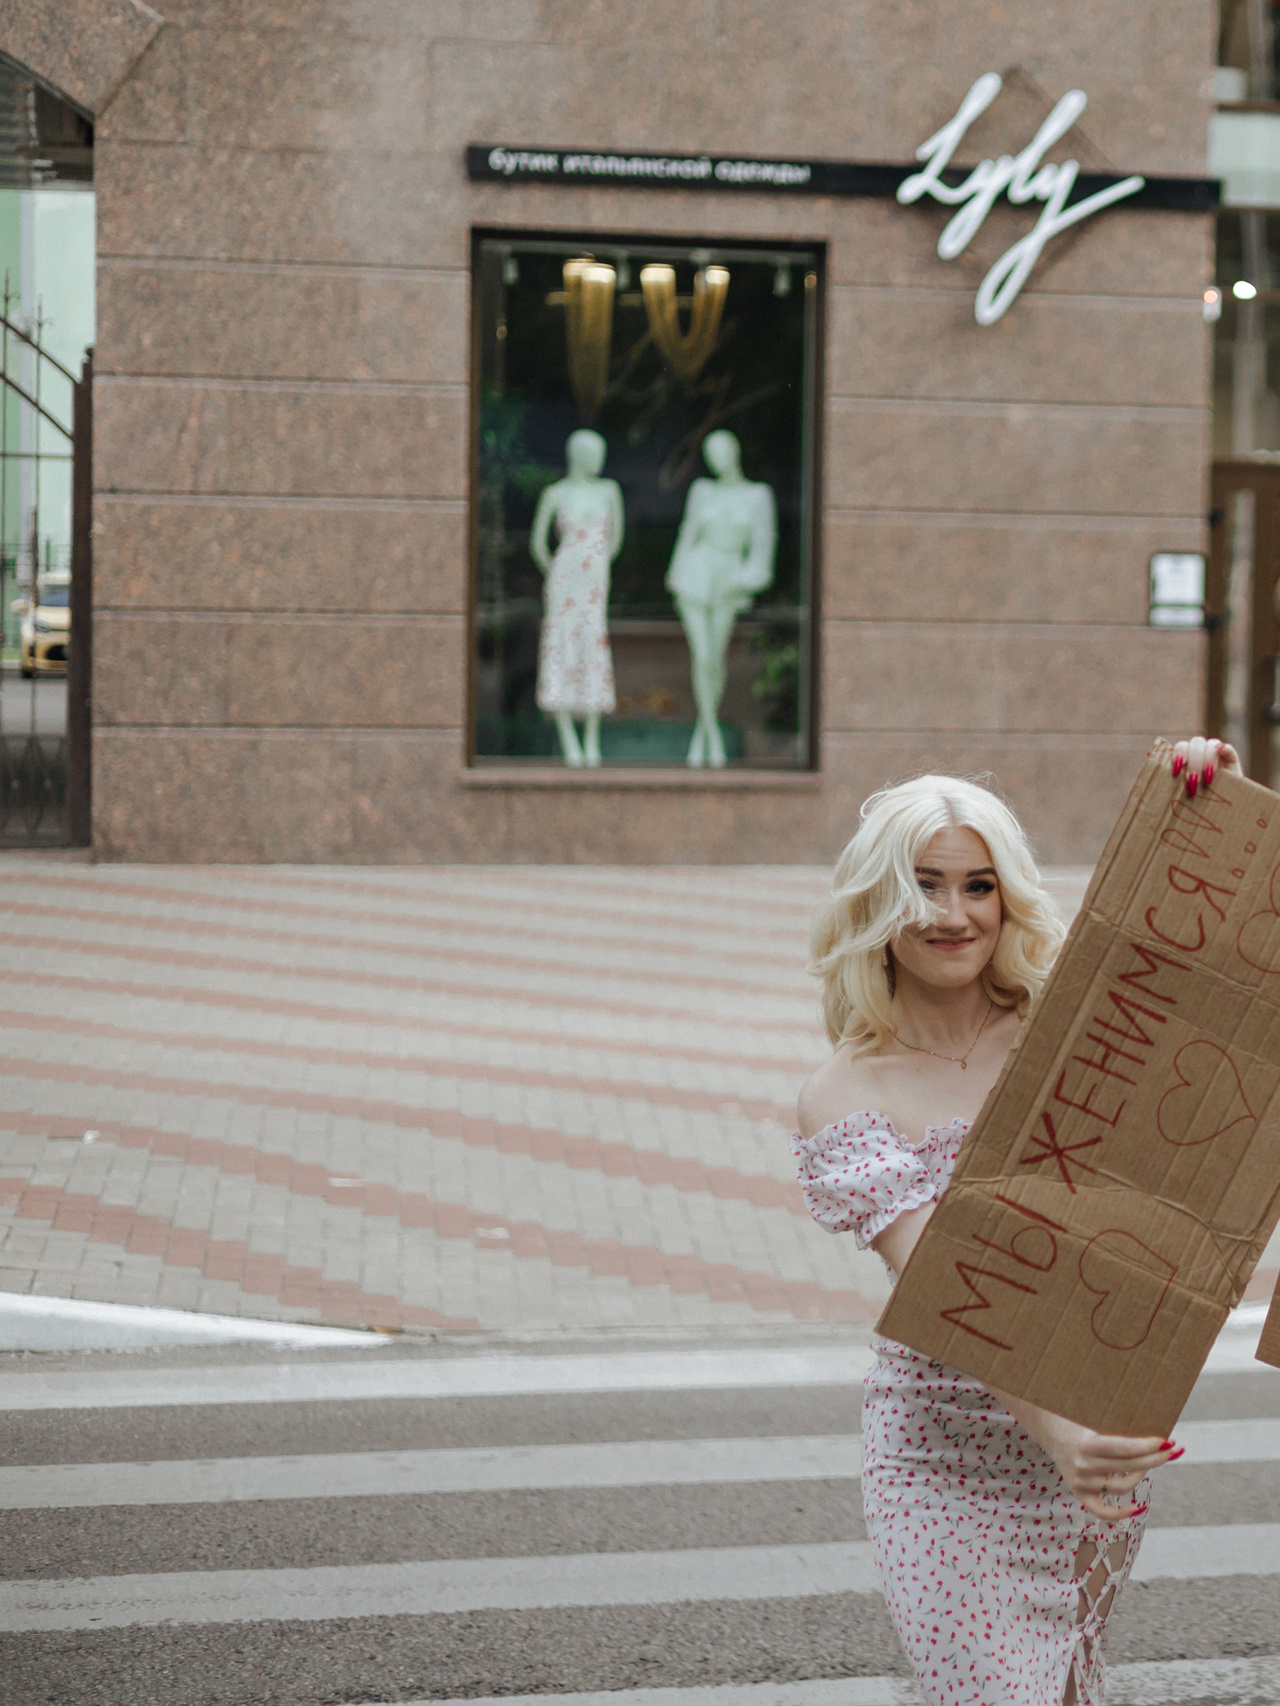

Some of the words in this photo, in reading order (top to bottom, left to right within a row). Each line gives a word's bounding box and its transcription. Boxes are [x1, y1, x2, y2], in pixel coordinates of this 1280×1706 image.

[488, 147, 558, 175] бутик
[562, 154, 713, 180] итальянской
[714, 160, 812, 185] одежды
[896, 71, 1146, 326] Lyly
[939, 1193, 1068, 1351] МЫ
